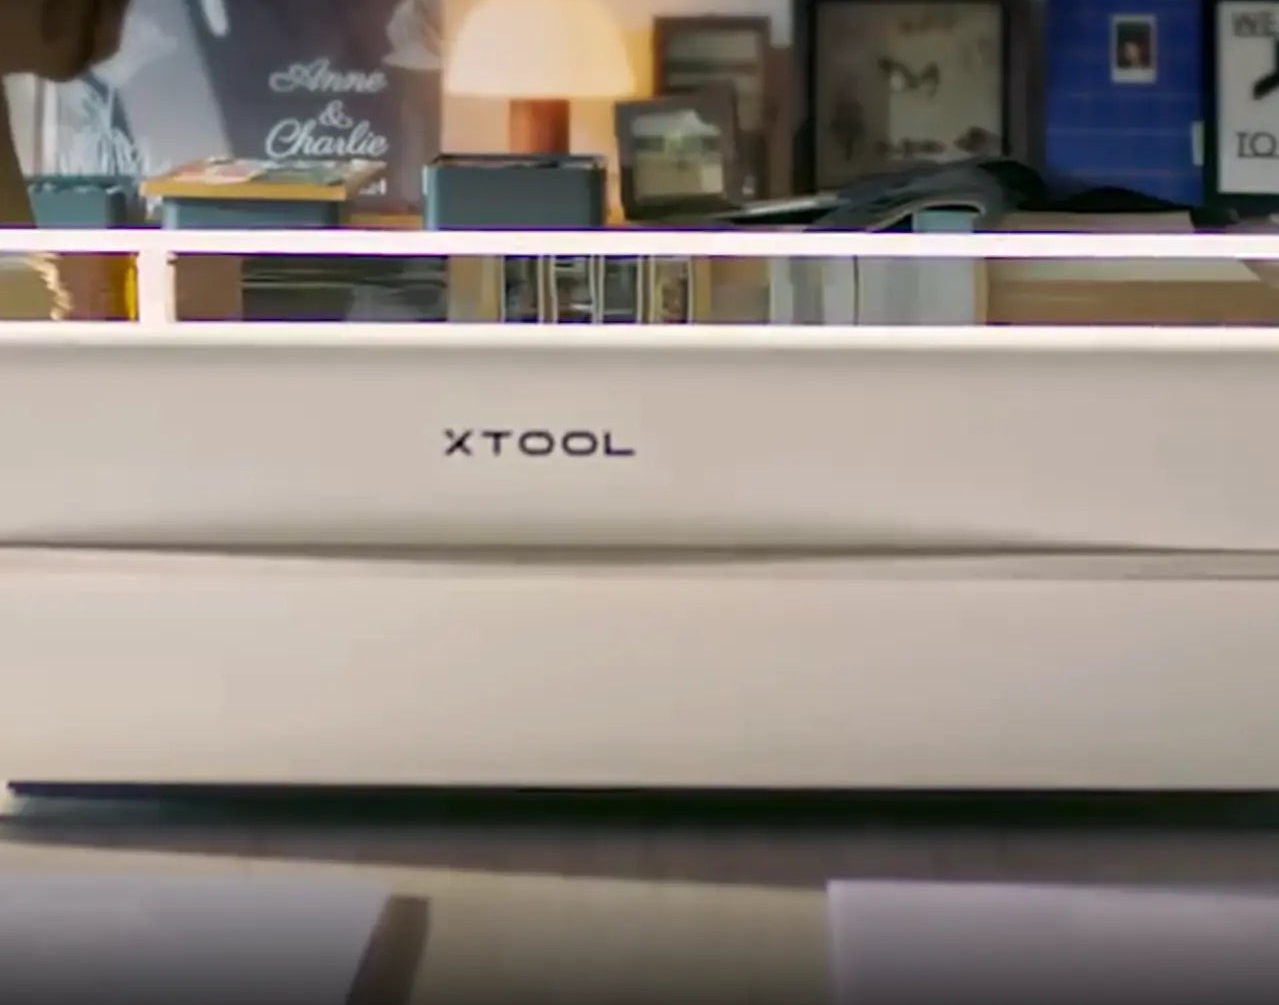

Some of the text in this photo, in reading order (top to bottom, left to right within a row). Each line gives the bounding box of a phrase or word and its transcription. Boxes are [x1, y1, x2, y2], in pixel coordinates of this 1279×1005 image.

[269, 58, 387, 95] Anne
[318, 100, 354, 128] &
[265, 120, 390, 161] Charlie
[1236, 132, 1277, 159] TO
[444, 428, 636, 457] XTOOL
